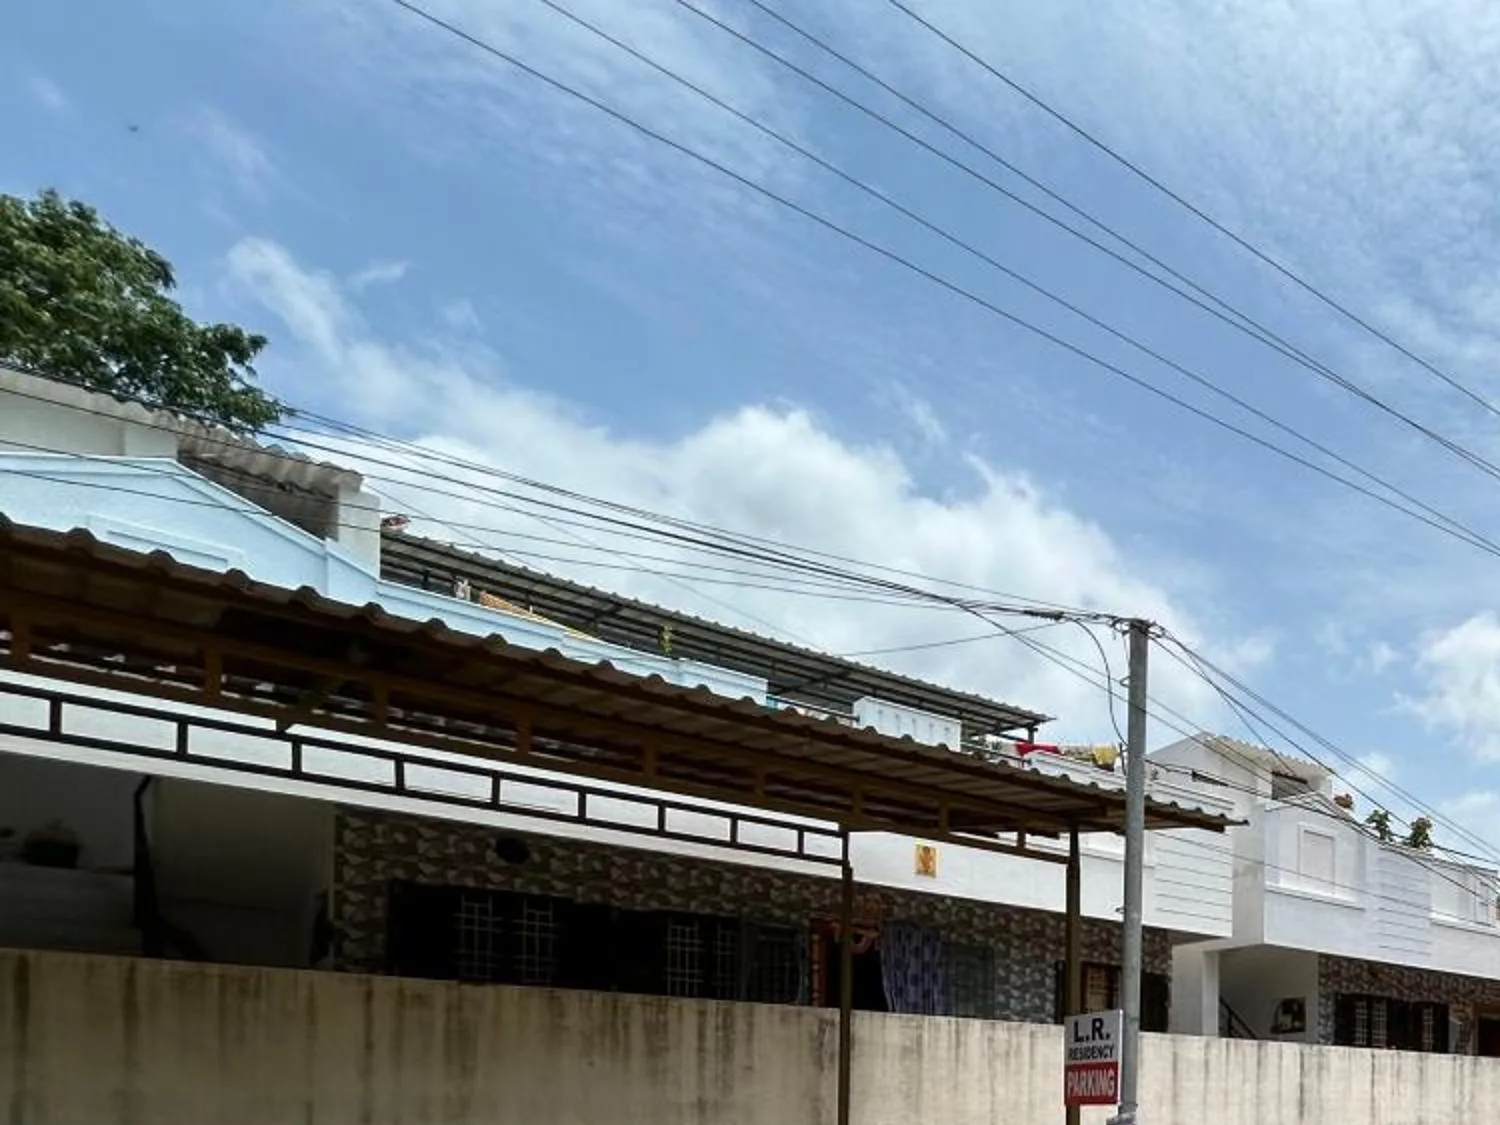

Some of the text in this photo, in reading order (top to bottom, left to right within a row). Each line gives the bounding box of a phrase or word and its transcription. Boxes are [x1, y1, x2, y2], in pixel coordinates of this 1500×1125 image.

[1073, 1017, 1110, 1042] L.R.
[1068, 1044, 1114, 1060] RESIDENCY
[1067, 1068, 1115, 1097] PARKING
